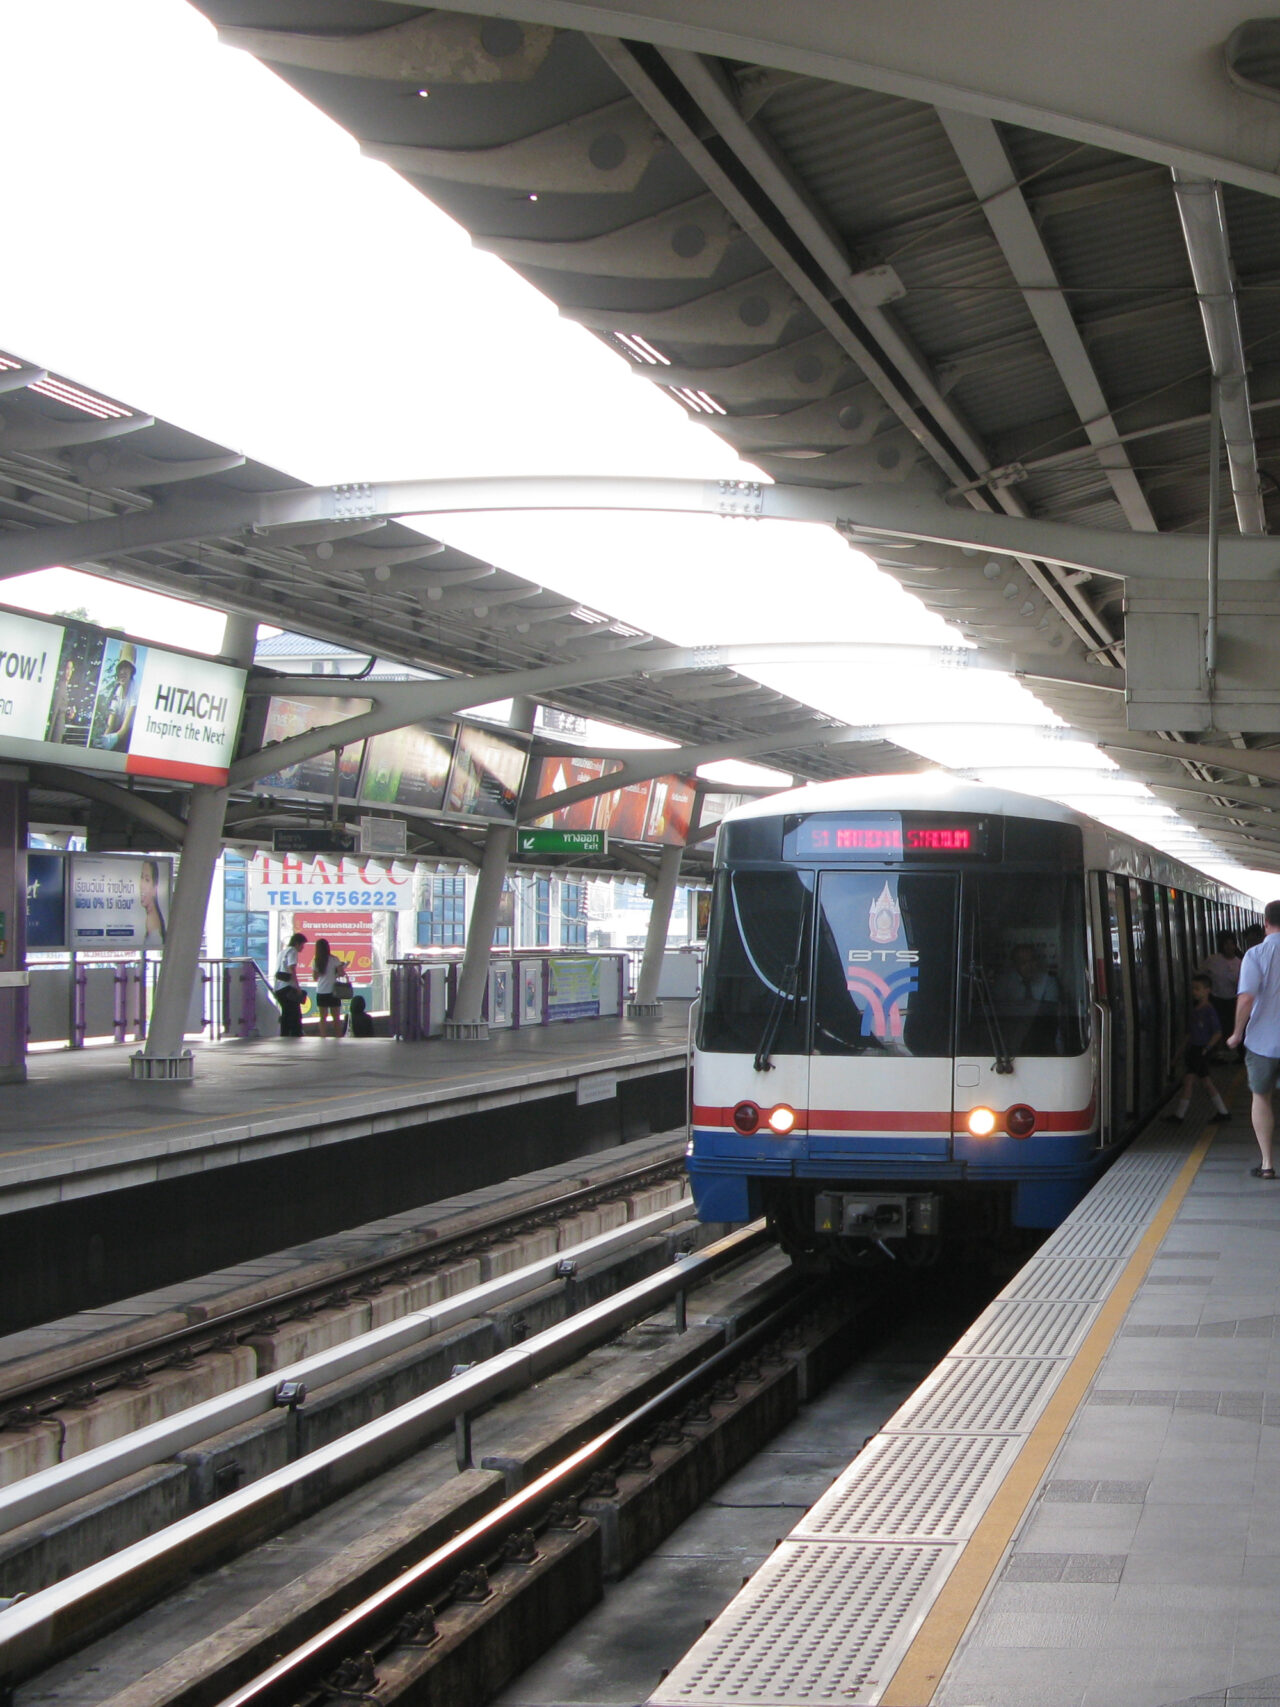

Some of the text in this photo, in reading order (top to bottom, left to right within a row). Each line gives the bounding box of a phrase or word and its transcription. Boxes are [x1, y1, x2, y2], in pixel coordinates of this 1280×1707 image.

[154, 684, 229, 723] HITACHI
[146, 715, 226, 746] Inspire the Next
[563, 833, 599, 843] ทางออก
[583, 842, 599, 850] Exit
[267, 890, 397, 906] TEL. 6756222
[848, 949, 920, 962] BTS
